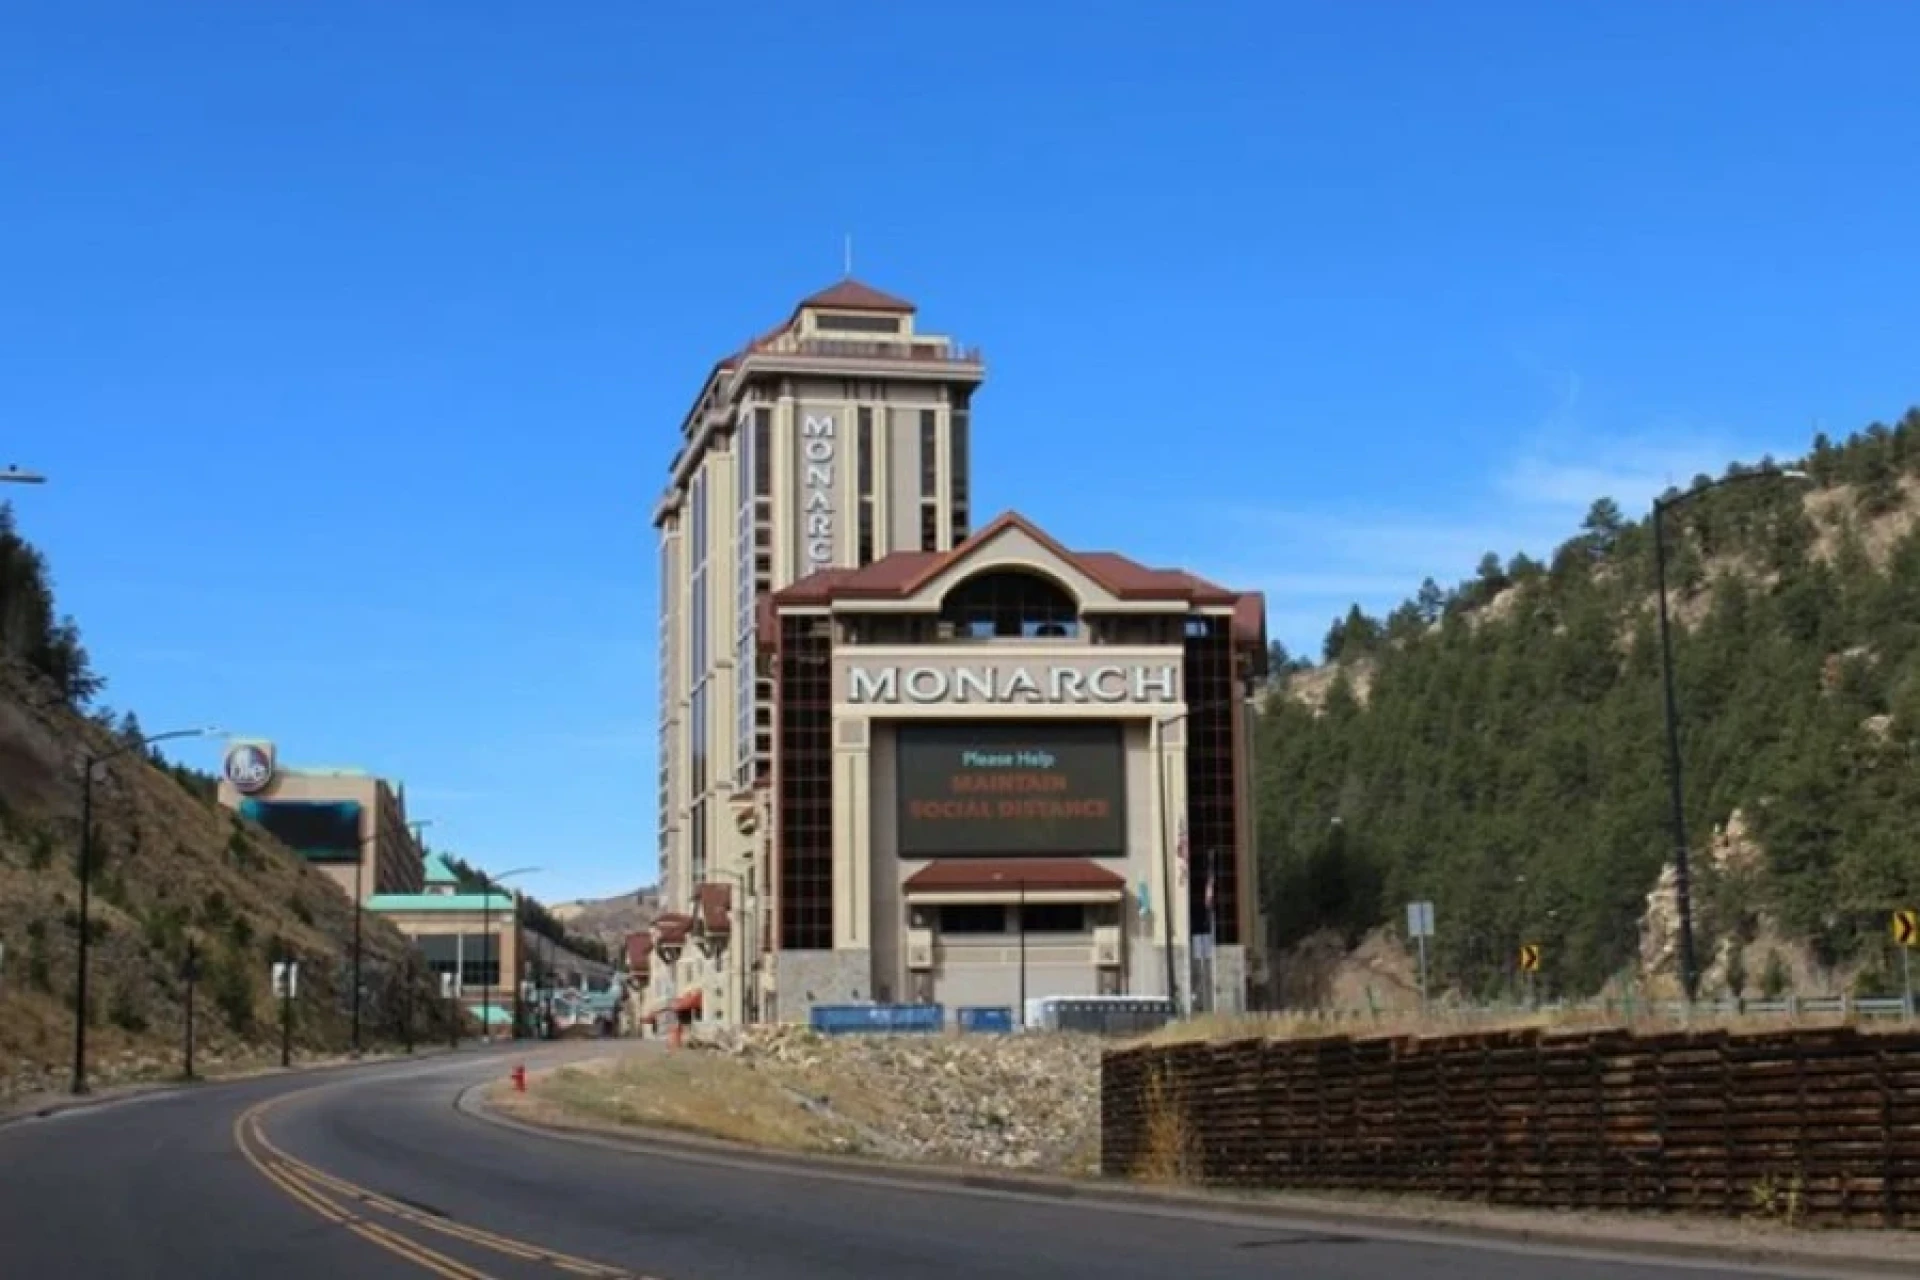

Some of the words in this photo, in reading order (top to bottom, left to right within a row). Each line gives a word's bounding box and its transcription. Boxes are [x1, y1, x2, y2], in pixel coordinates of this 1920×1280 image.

[803, 414, 834, 575] MONARC
[848, 665, 1176, 704] MONARCH
[962, 750, 1012, 767] Please
[1016, 750, 1056, 768] Help
[951, 774, 1067, 792] MAINTAIN
[911, 801, 991, 818] SOCIAL
[1001, 801, 1108, 818] DISTANCE
